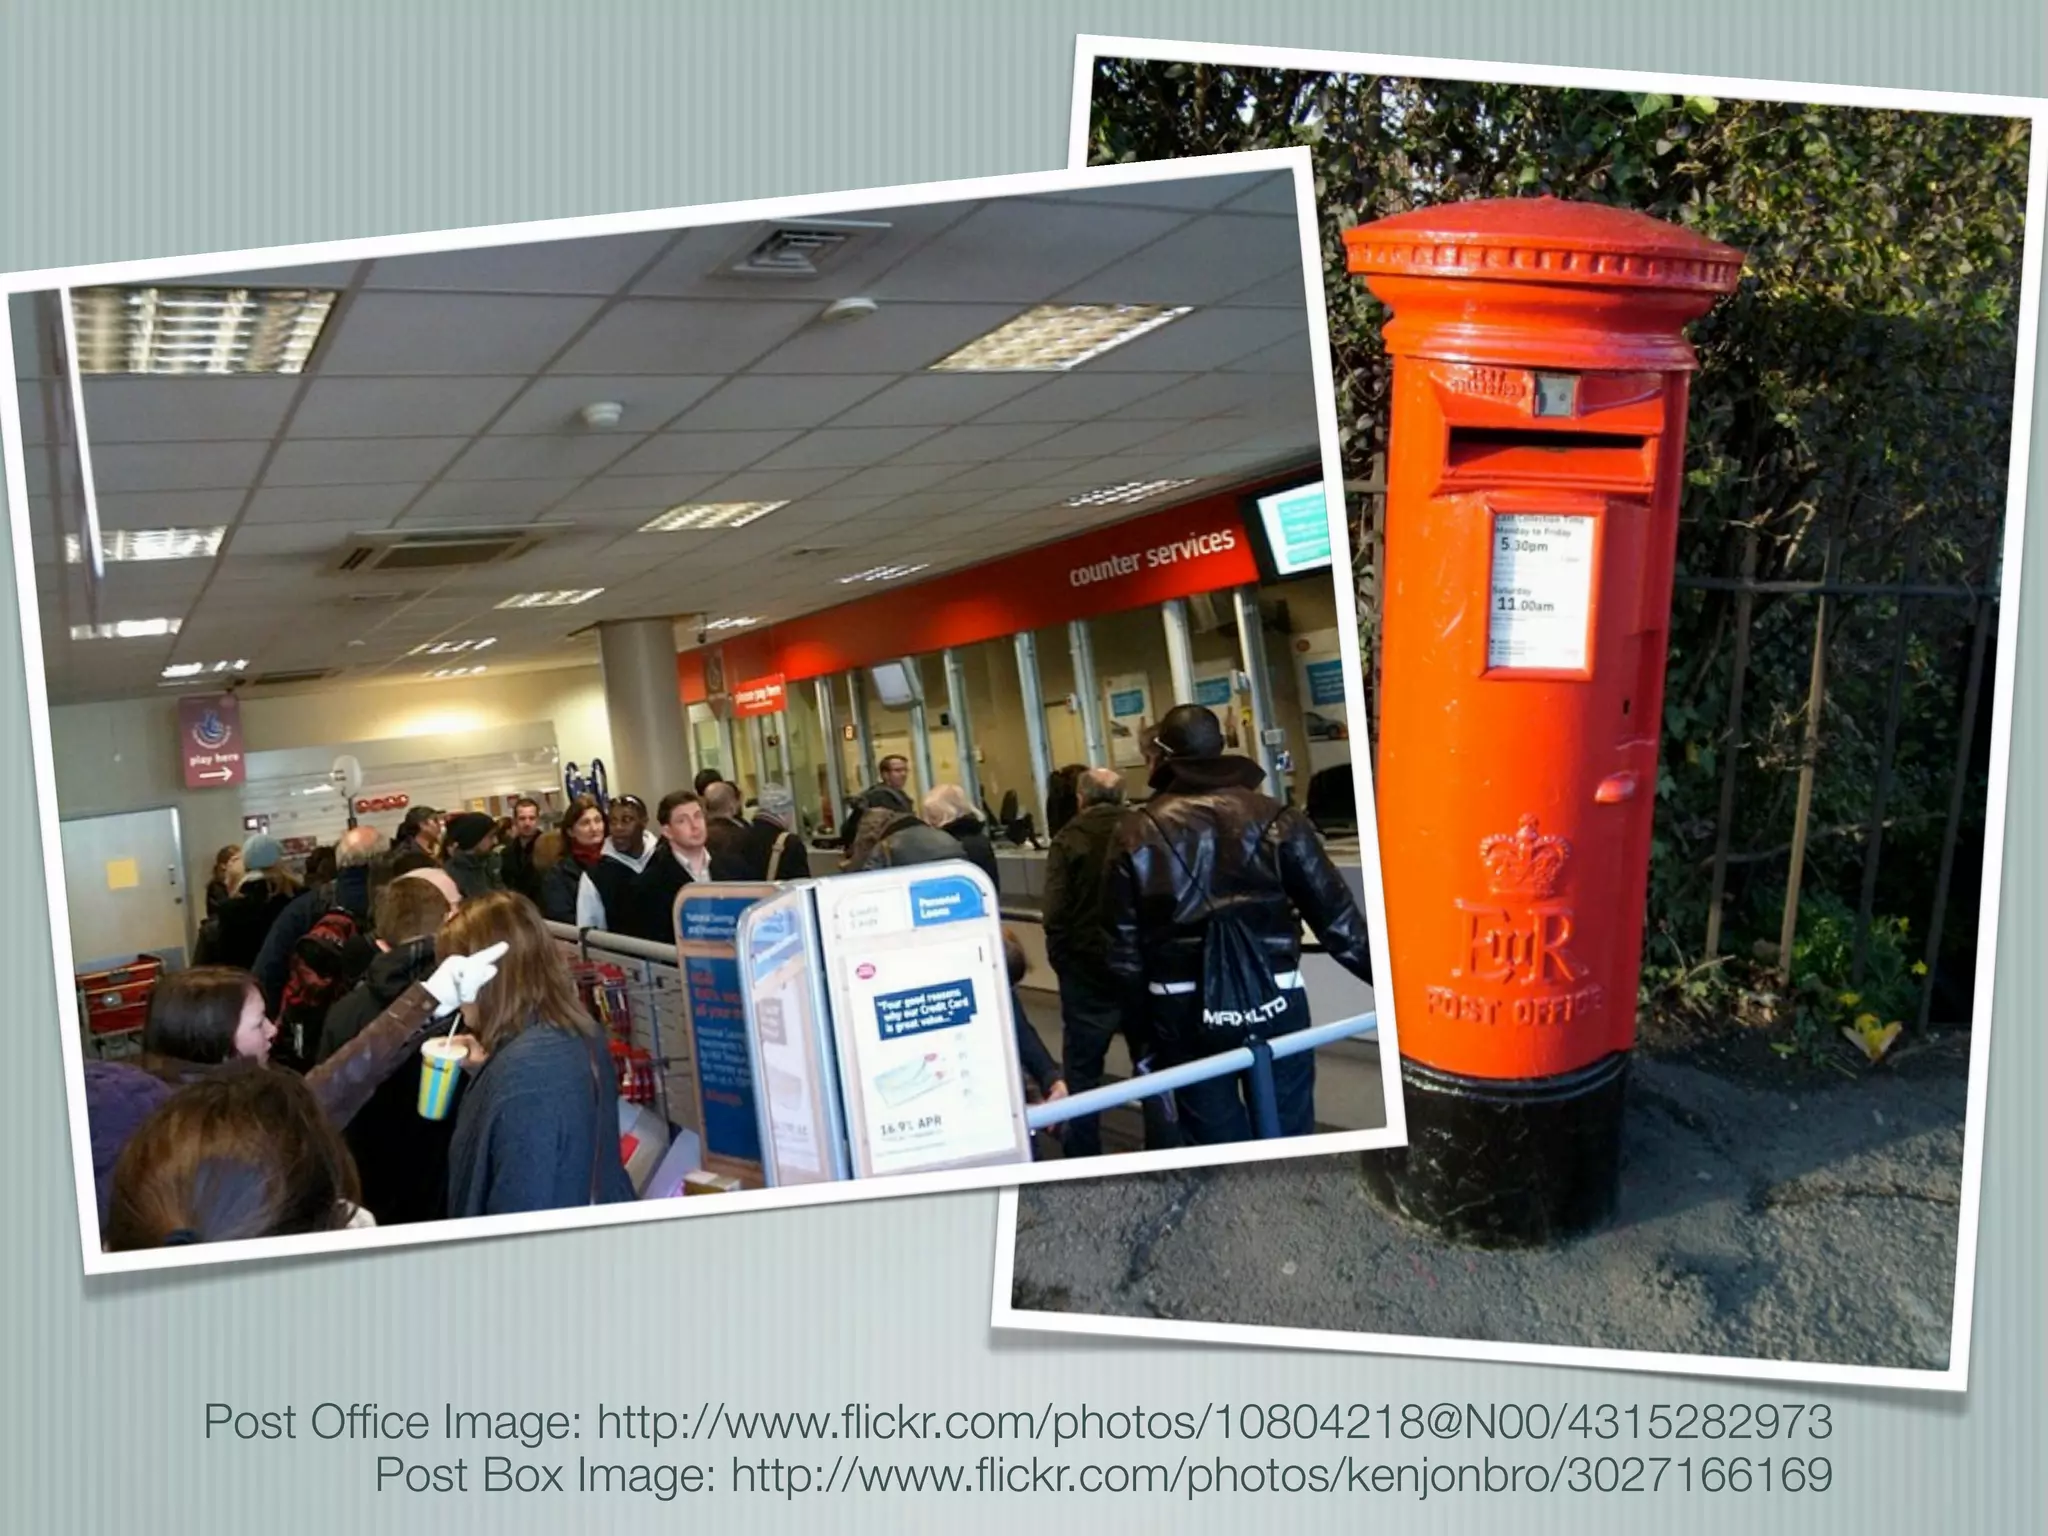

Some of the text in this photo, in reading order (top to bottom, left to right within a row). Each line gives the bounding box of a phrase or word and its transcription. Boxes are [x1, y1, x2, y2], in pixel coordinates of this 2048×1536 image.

[1070, 553, 1141, 587] counter
[1146, 529, 1236, 567] services
[1498, 597, 1554, 612] 11.00am
[190, 753, 239, 767] play here
[921, 1002, 947, 1014] Credit
[948, 998, 969, 1010] Card
[1427, 984, 1502, 1025] POST
[918, 1113, 942, 1129] APR
